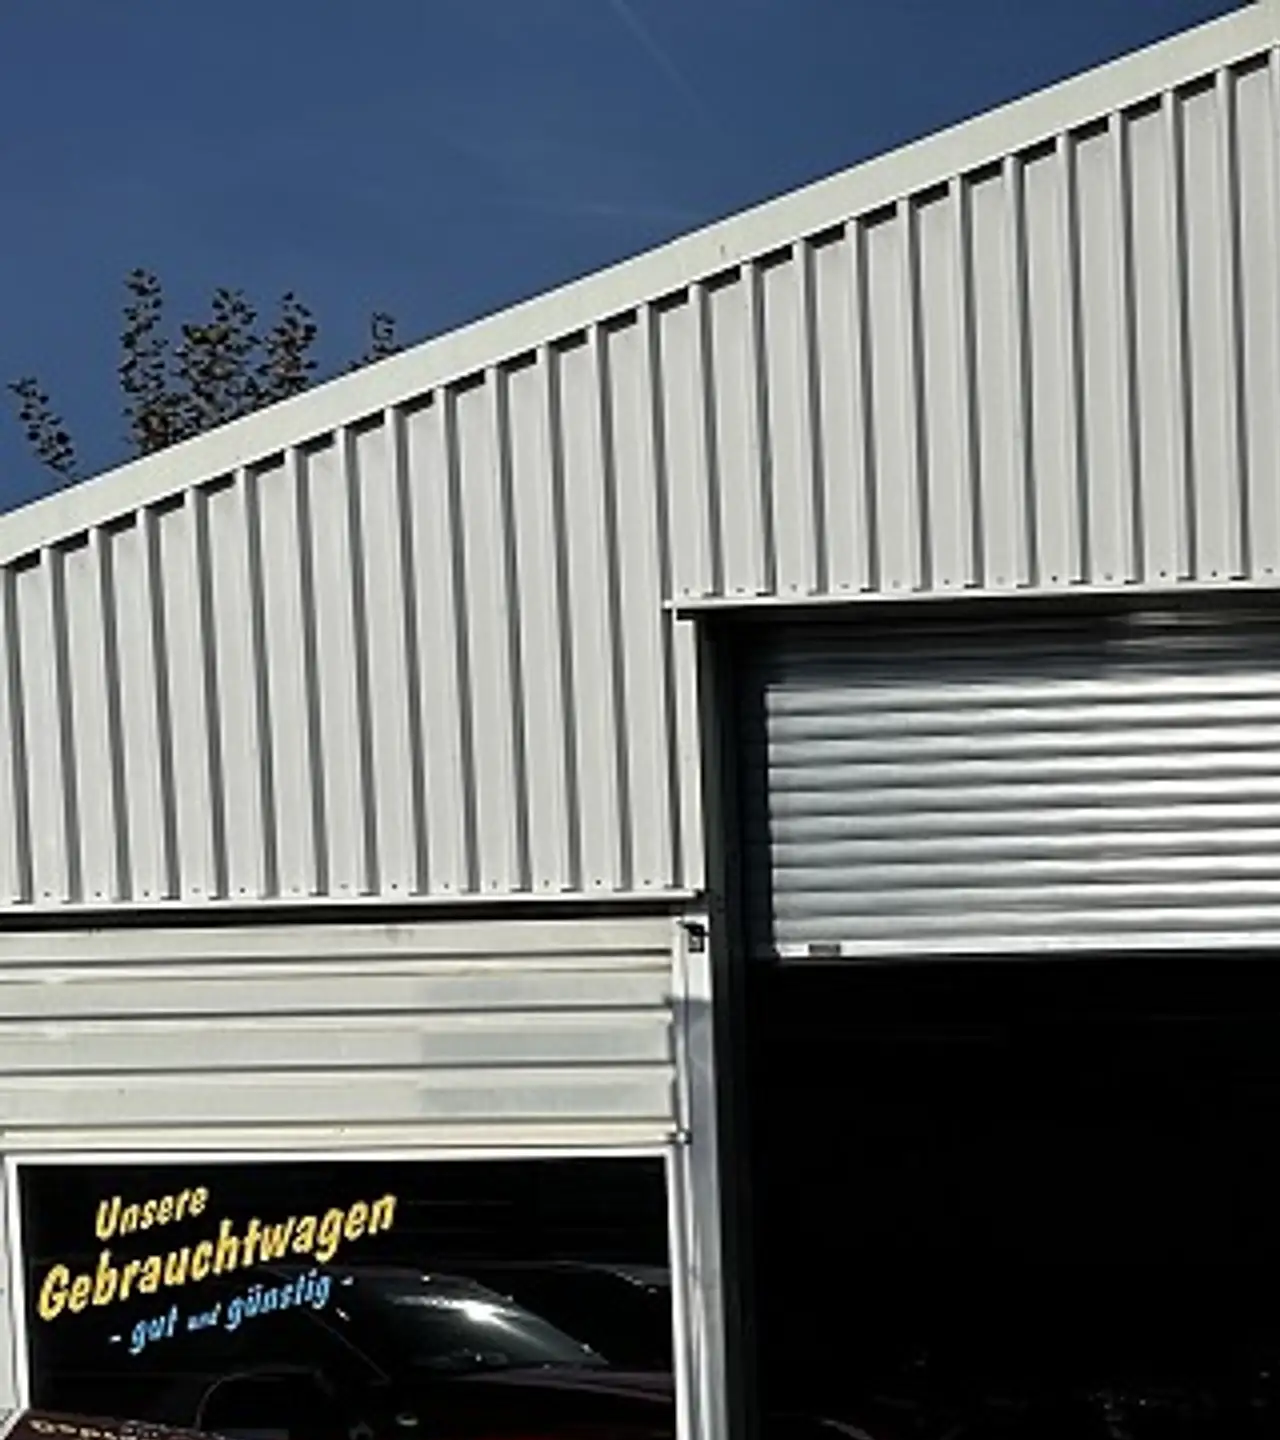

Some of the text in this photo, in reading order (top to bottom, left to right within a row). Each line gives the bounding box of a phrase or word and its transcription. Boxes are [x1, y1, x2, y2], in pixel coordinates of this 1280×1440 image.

[36, 1185, 399, 1322] Unsere Gebrauchtwagen
[128, 1304, 178, 1356] gut
[224, 1268, 334, 1332] günstig
